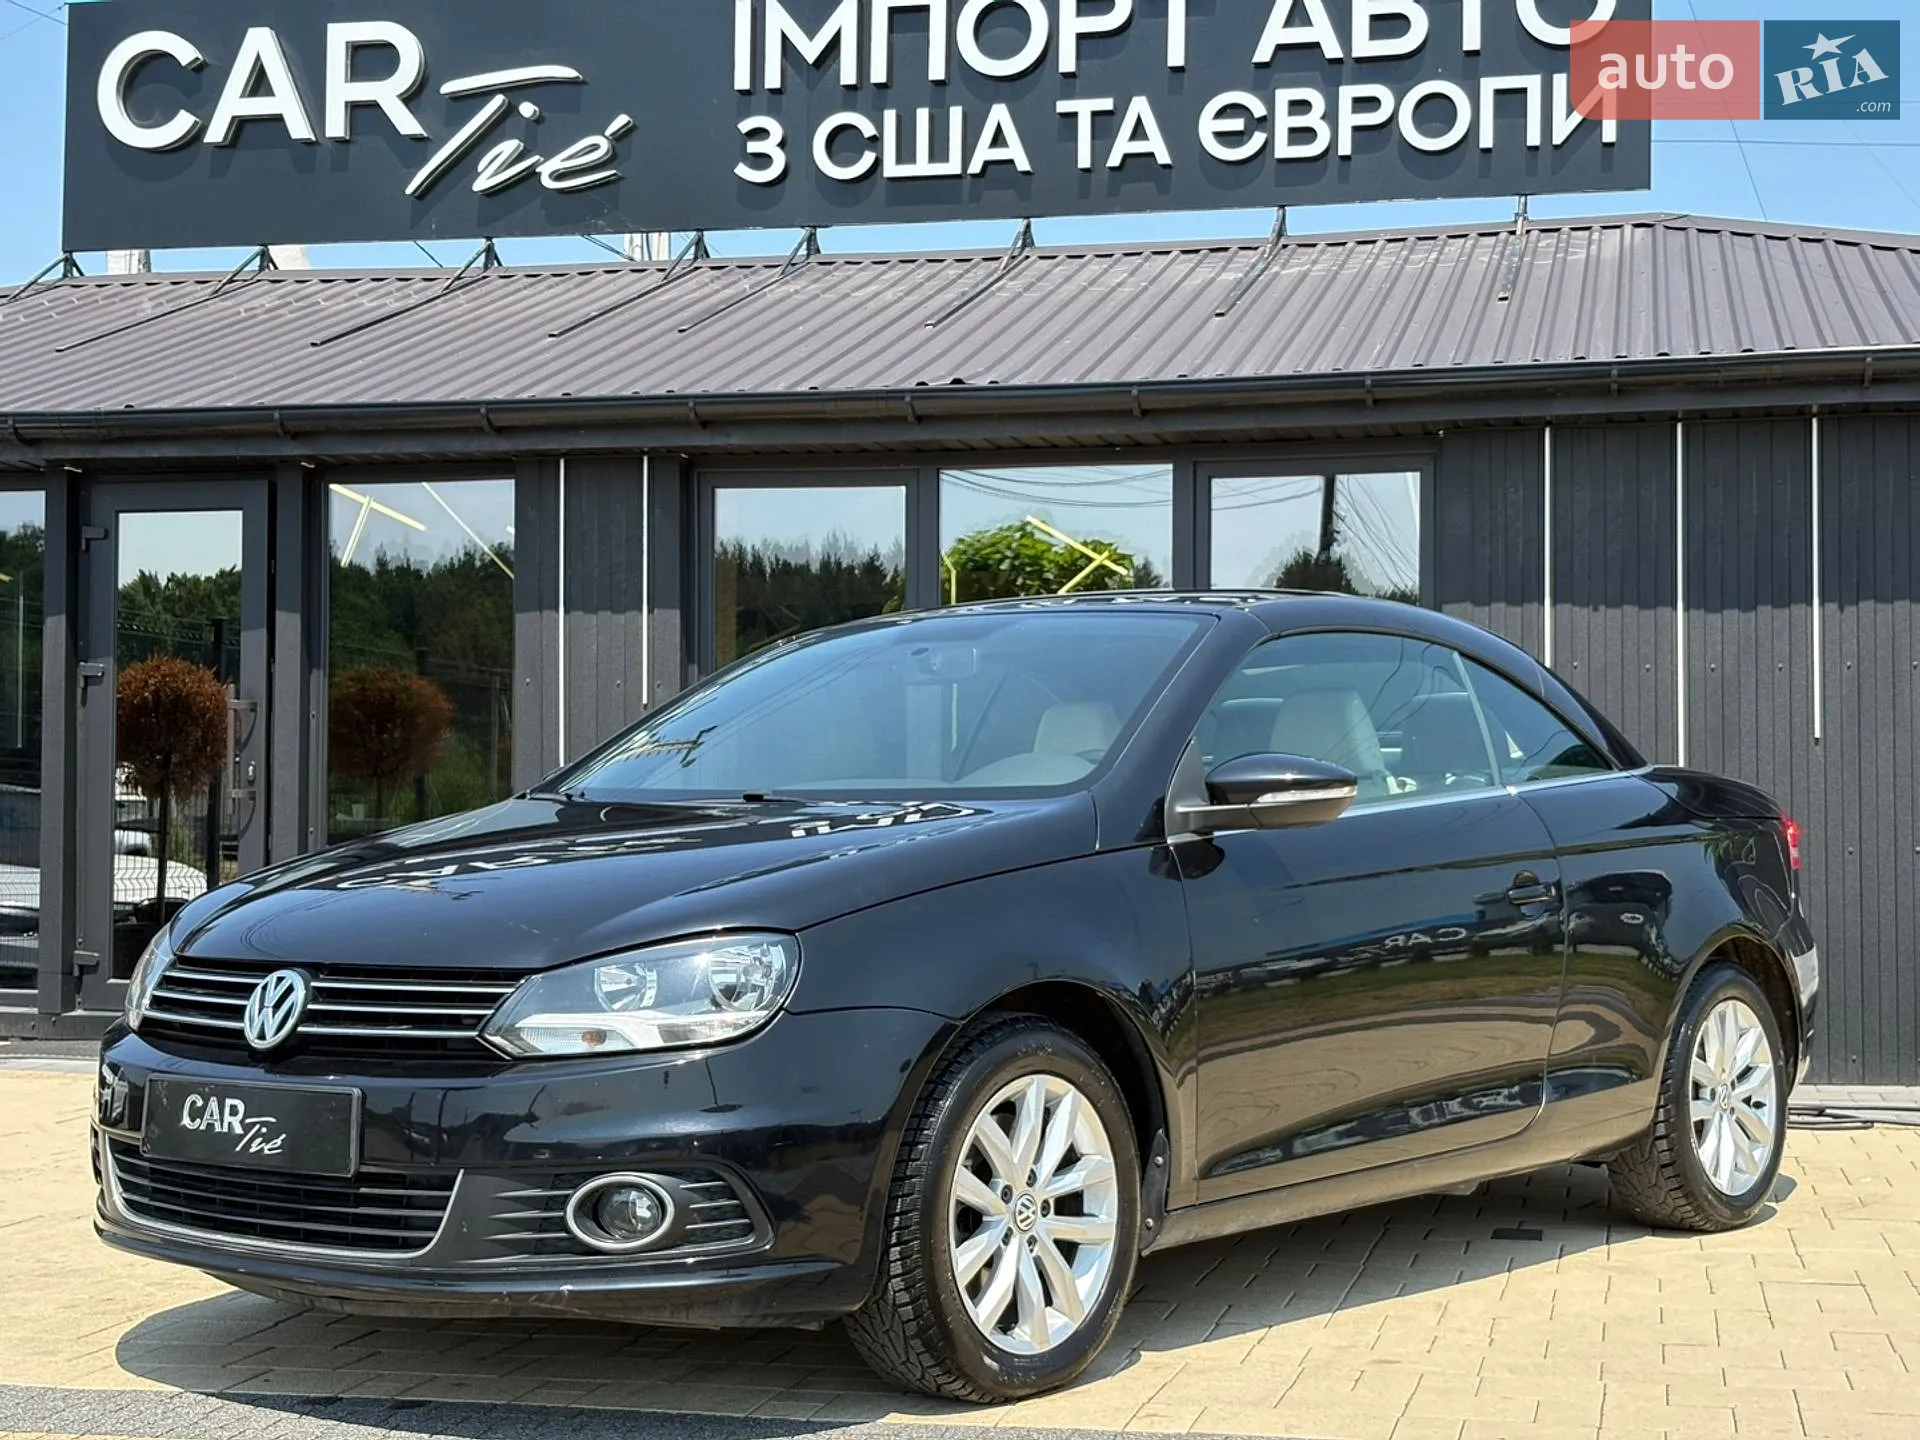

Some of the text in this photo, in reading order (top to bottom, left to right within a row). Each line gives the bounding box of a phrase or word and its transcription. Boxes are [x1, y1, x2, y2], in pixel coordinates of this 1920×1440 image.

[97, 20, 635, 197] CAR Tié
[733, 72, 1618, 185] З США ТА ЄВРОПИ
[181, 1093, 246, 1135] CAR
